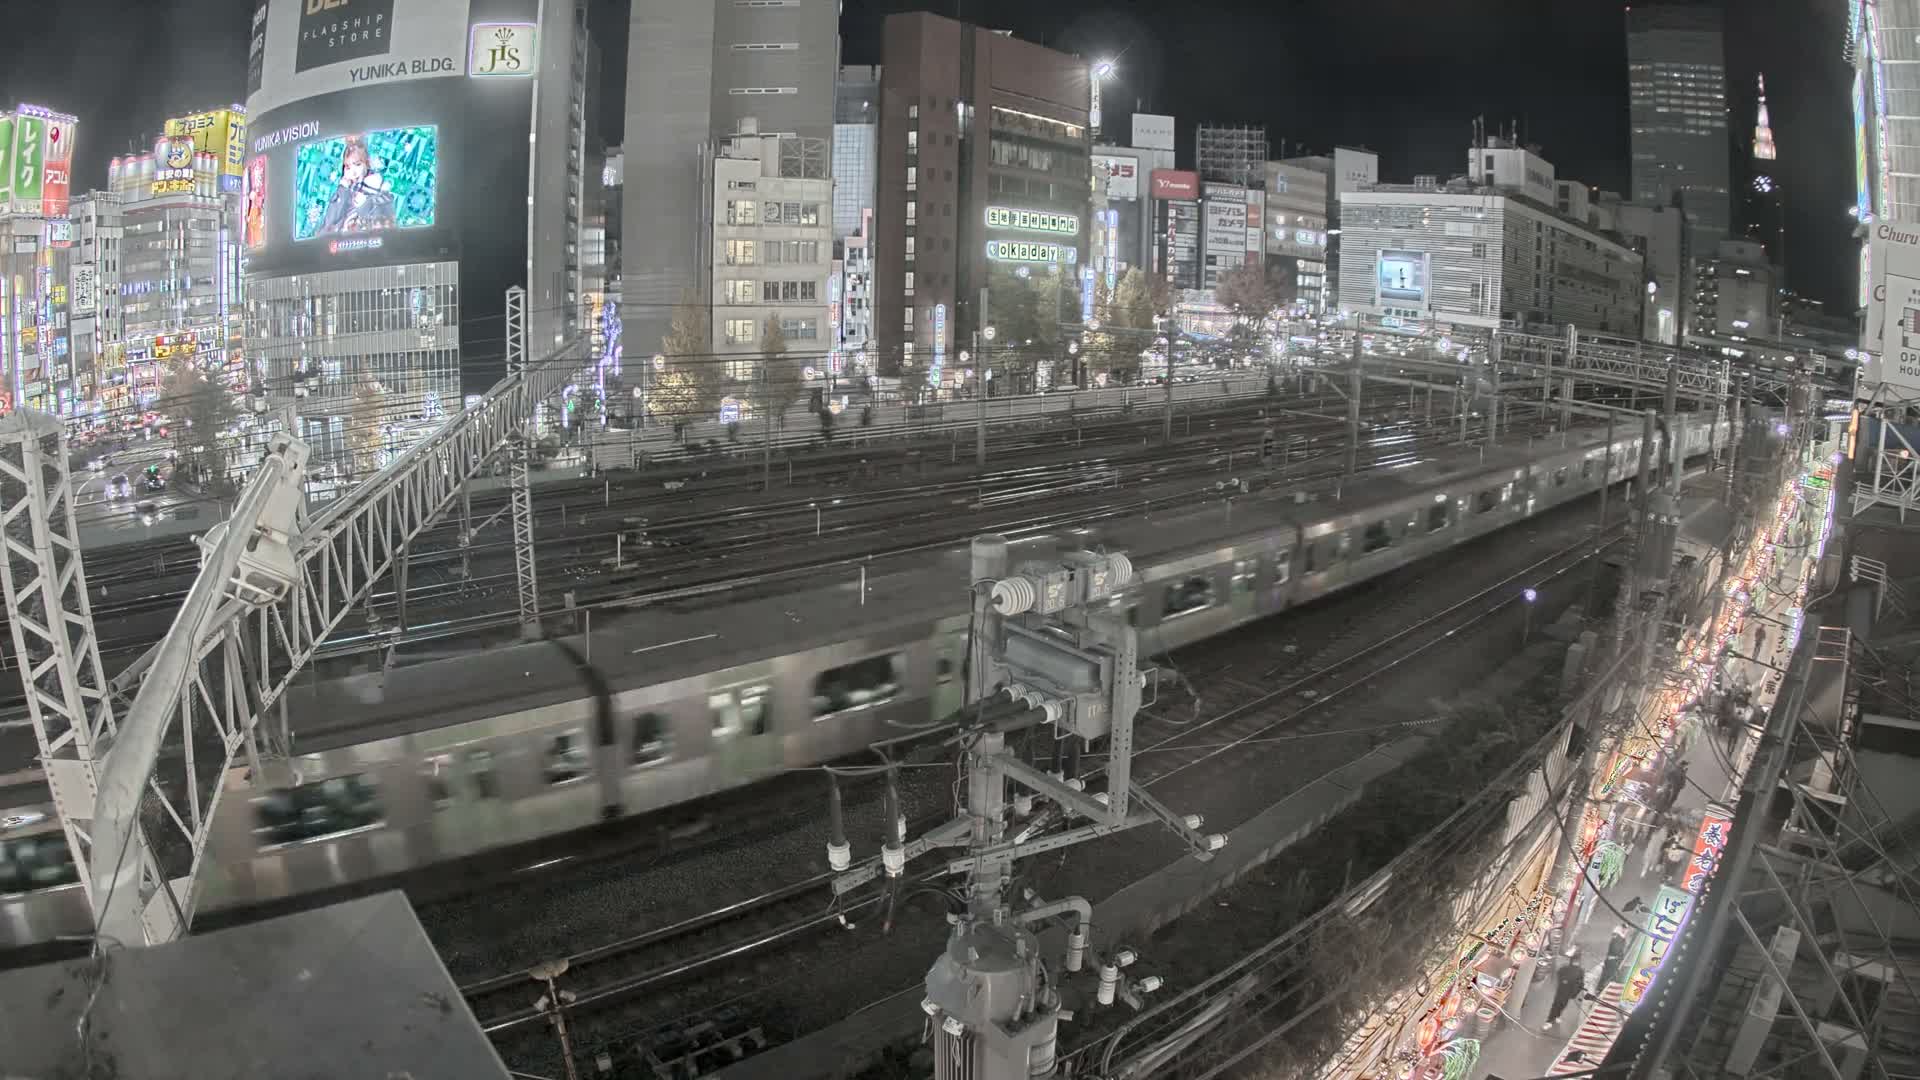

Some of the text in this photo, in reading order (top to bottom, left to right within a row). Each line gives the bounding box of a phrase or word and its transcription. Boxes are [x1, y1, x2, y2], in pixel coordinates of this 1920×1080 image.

[303, 14, 383, 40] FLAGSHIP
[328, 28, 381, 47] STORE
[350, 58, 455, 82] YUNIKA BLDG.
[254, 121, 320, 152] YUNIKA VISION
[22, 121, 37, 188] レイク
[46, 168, 68, 184] アコム
[1901, 352, 1920, 365] OP
